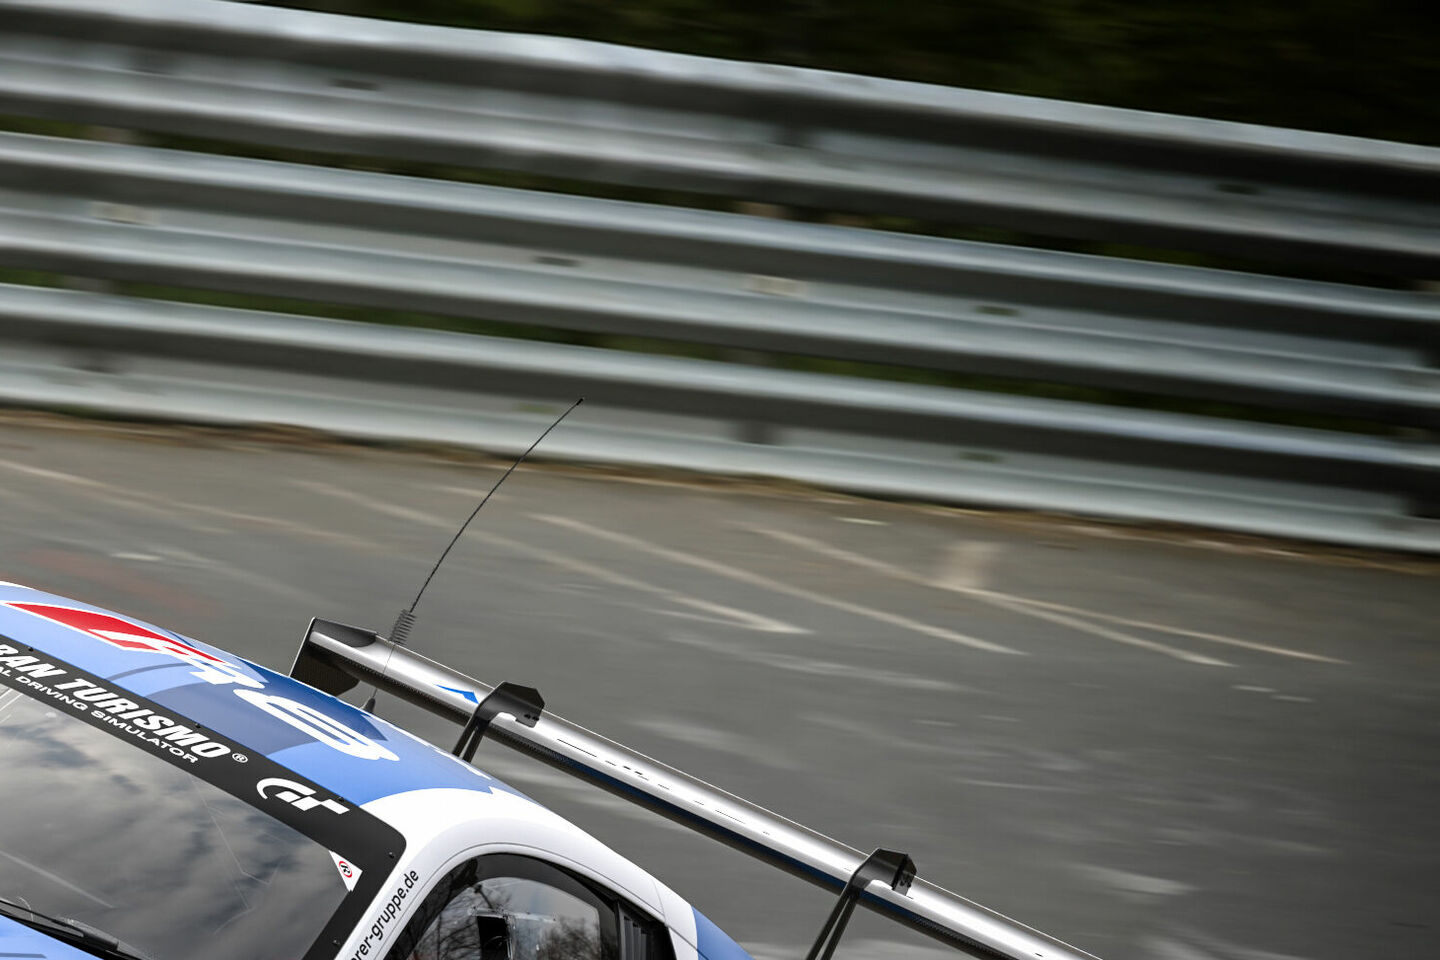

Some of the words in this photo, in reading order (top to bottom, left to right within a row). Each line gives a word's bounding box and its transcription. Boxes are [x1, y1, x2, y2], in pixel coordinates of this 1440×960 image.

[15, 676, 88, 711] DRIVING
[91, 710, 198, 764] SIMULATOR
[54, 678, 231, 758] TURISMO
